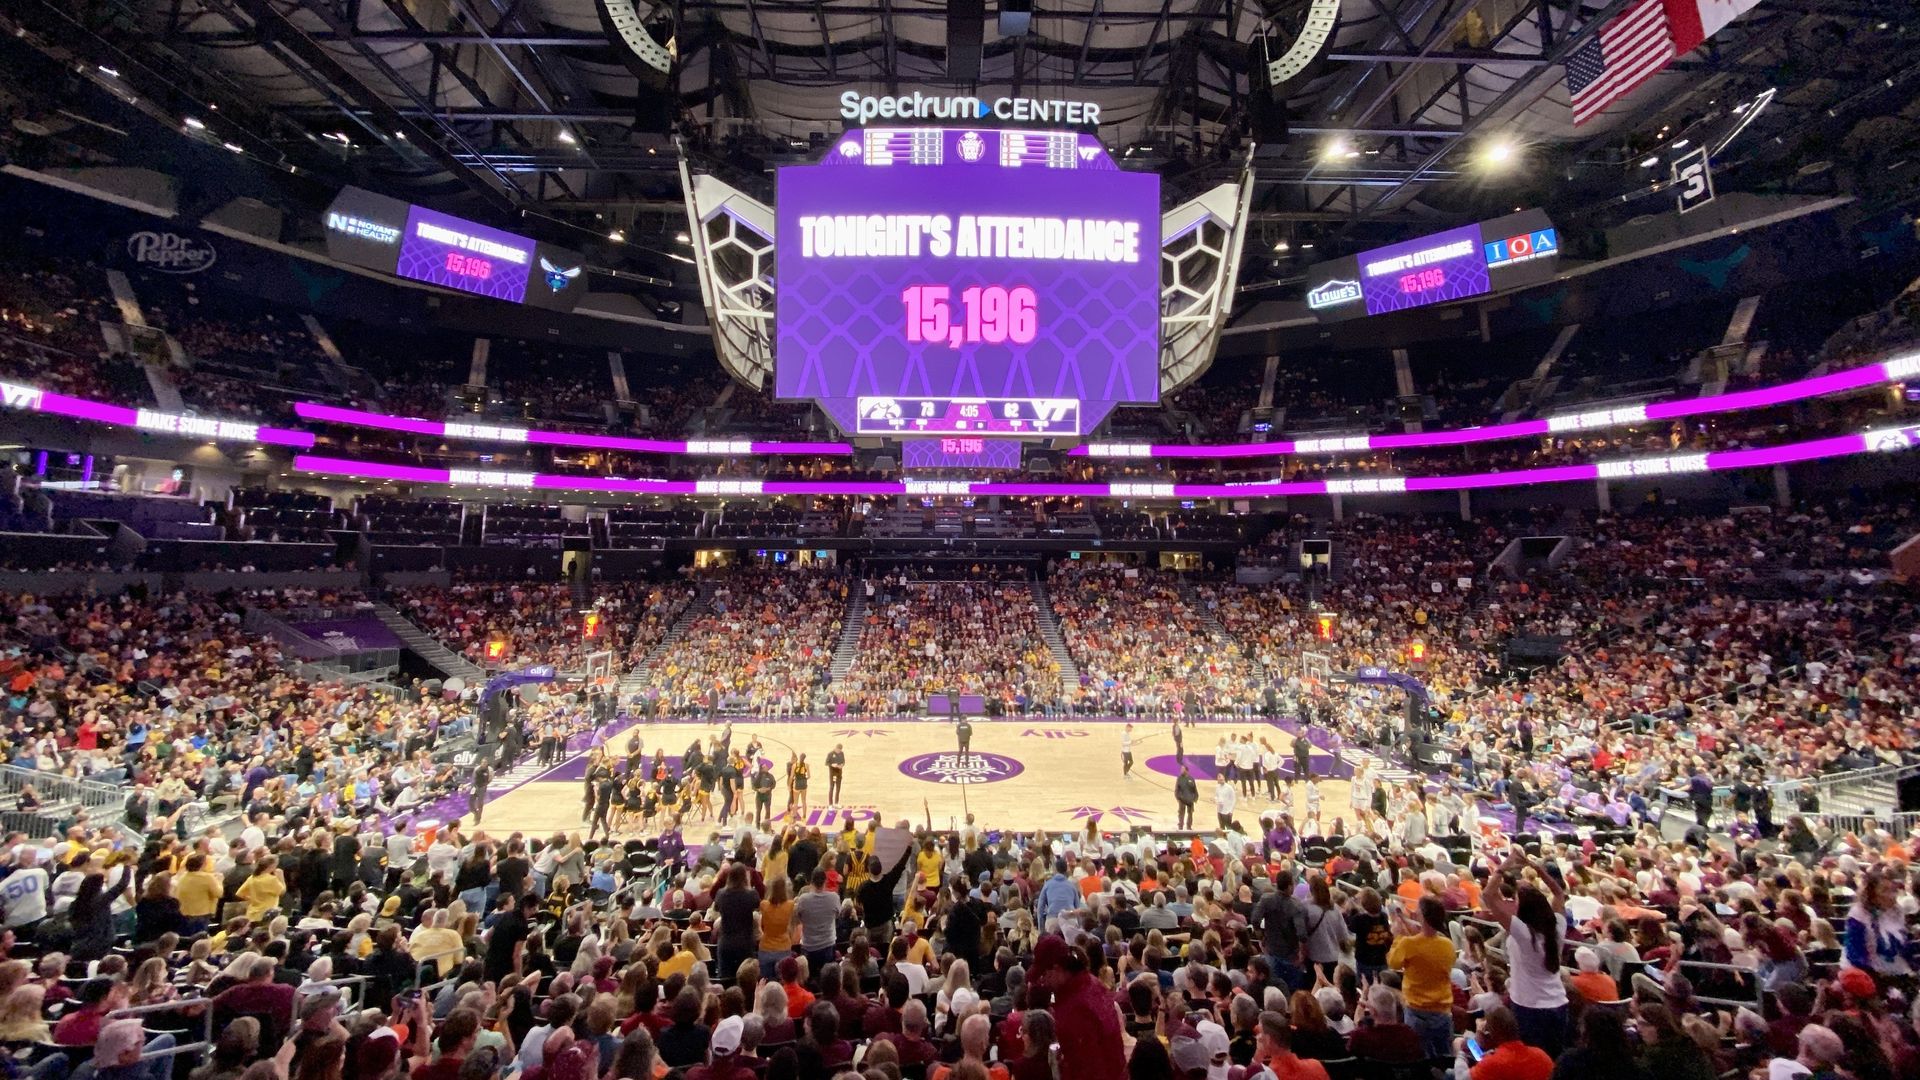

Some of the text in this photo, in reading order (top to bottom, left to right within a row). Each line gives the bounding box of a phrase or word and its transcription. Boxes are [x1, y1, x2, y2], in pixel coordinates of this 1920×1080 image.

[840, 91, 1100, 125] Spectrum CENTER
[356, 227, 395, 243] HEALTH
[357, 220, 400, 237] NOVANT
[160, 232, 192, 250] Dr
[799, 214, 1139, 262] TONIGHT'S ATTENDANCE
[137, 231, 210, 267] Pepper
[445, 252, 492, 280] 15,196
[1400, 268, 1444, 293] 15,196
[1314, 284, 1356, 304] LOWE'S
[902, 284, 1038, 349] 15,196
[960, 404, 979, 418] 4:05
[137, 409, 258, 441] MAKE SOME NOISE
[941, 438, 984, 454] 15,196
[529, 666, 549, 677] ally
[1364, 667, 1382, 678] ally
[453, 750, 477, 765] ally
[1432, 750, 1452, 764] ally
[938, 775, 988, 784] ally
[6, 874, 38, 900] 50
